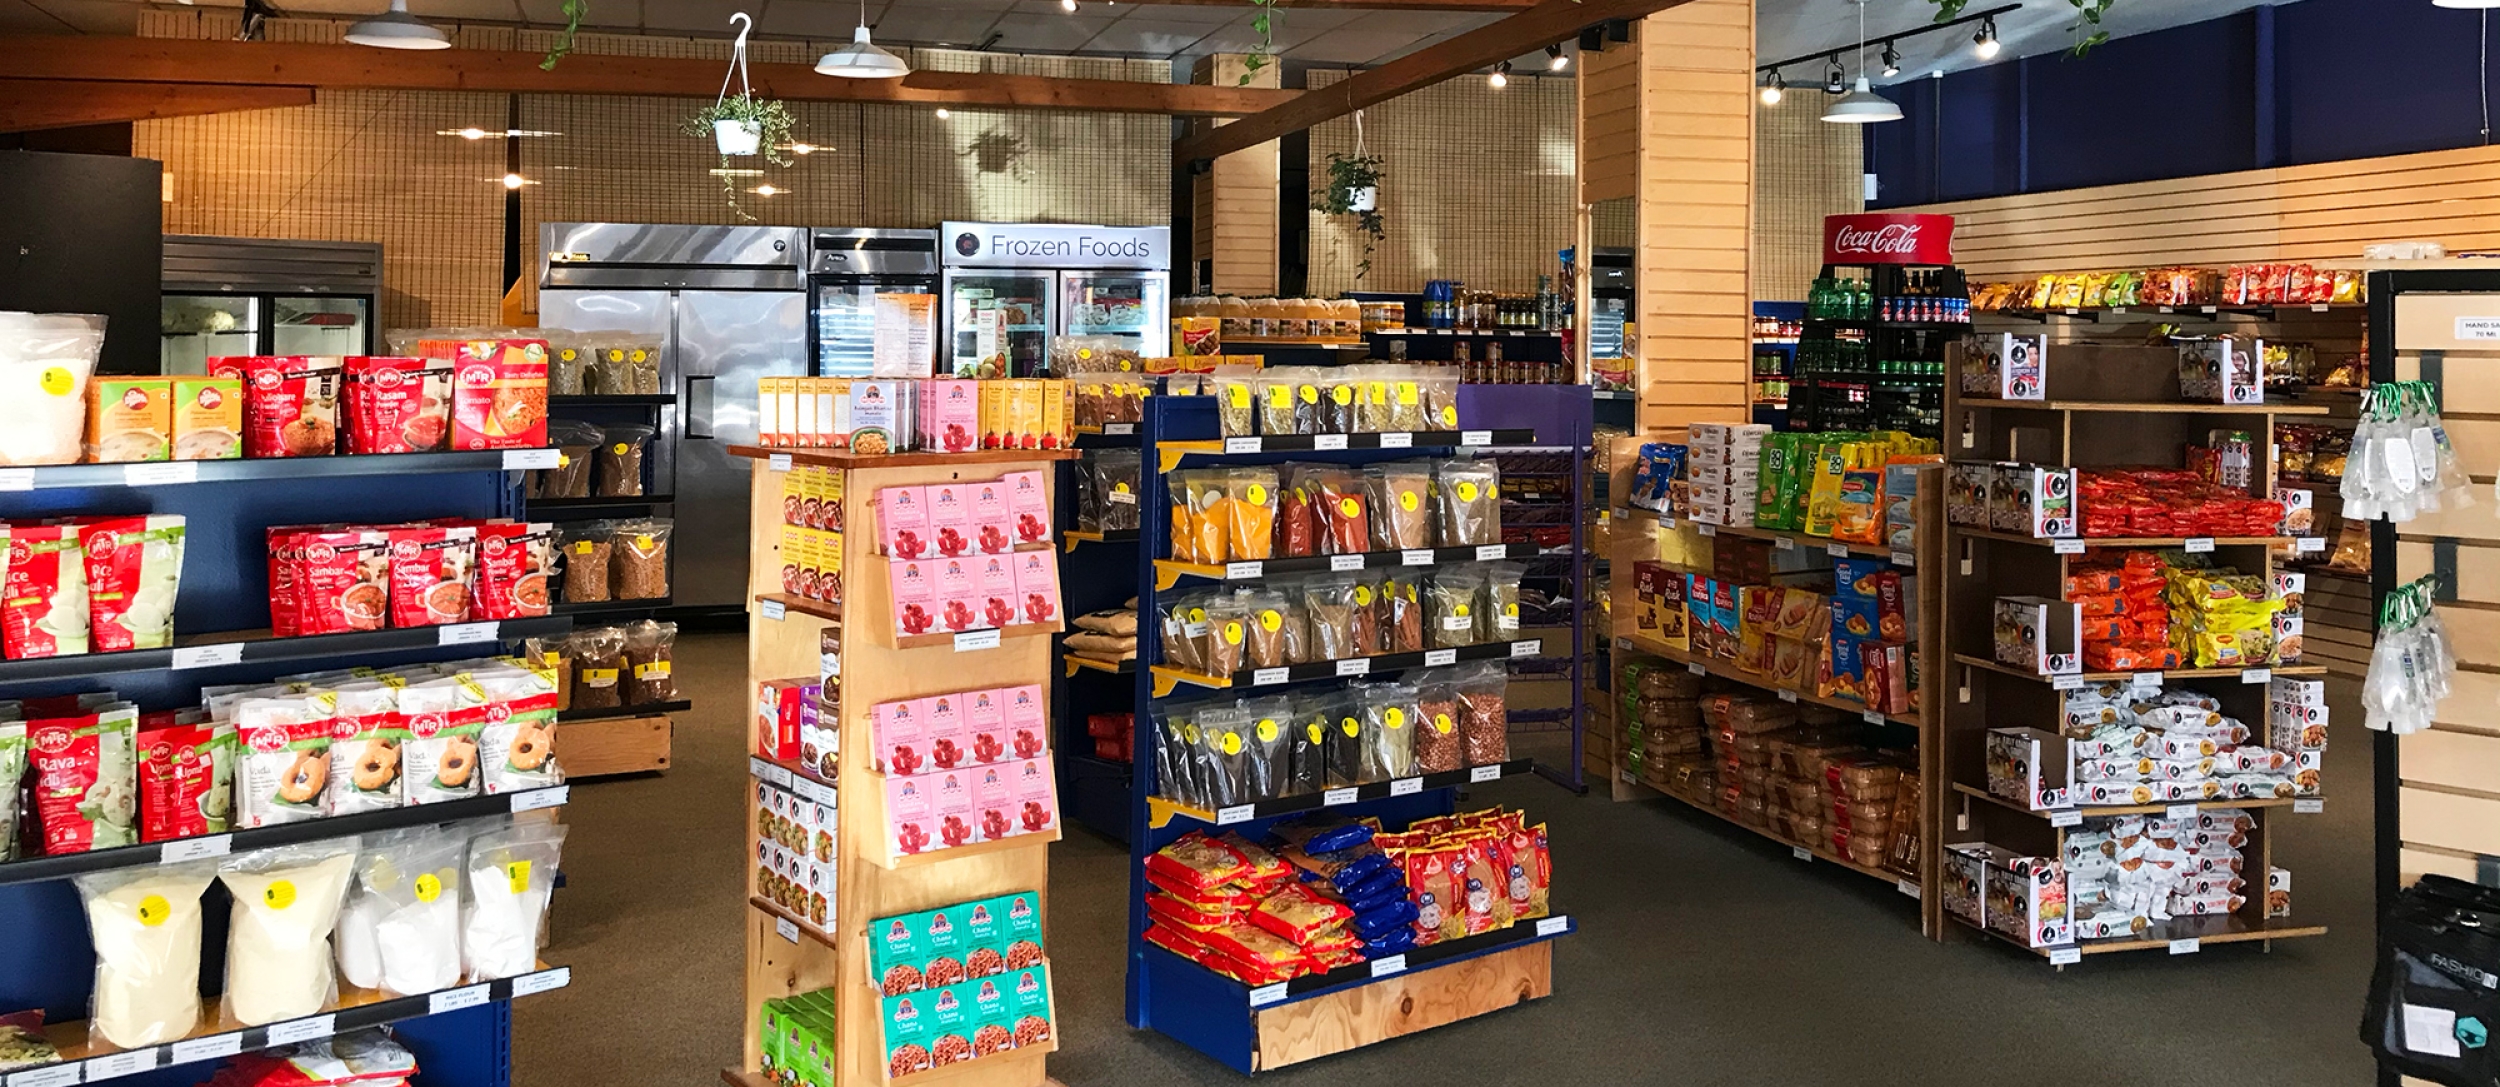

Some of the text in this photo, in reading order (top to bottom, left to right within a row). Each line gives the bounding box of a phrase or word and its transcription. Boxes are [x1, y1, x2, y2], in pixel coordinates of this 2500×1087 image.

[1835, 223, 1923, 254] Coca-Cola
[992, 235, 1150, 257] Frozen Foods
[465, 370, 490, 382] MTR
[376, 391, 407, 400] Rasam
[92, 539, 113, 554] MTR
[488, 541, 502, 550] MTR
[310, 548, 332, 559] MTR
[487, 557, 516, 568] Sambar
[309, 565, 344, 577] Sambar
[395, 563, 430, 574] Sambar
[7, 571, 28, 583] ice
[1639, 580, 1654, 593] Rusk
[1665, 586, 1681, 600] Rusk
[415, 719, 437, 734] MTR
[40, 732, 67, 745] MTR
[256, 733, 284, 747] MTR
[39, 756, 75, 771] Rava
[151, 762, 173, 775] Upm
[250, 767, 271, 775] Vada
[1013, 918, 1031, 926] Chana
[972, 926, 992, 934] Chana
[932, 935, 952, 943] Chana
[890, 942, 910, 950] Chana
[2431, 953, 2498, 989] FASHION
[1019, 993, 1039, 1002] Chana
[980, 1002, 999, 1011] Chana
[939, 1011, 959, 1020] Chana
[897, 1021, 918, 1029] Chana
